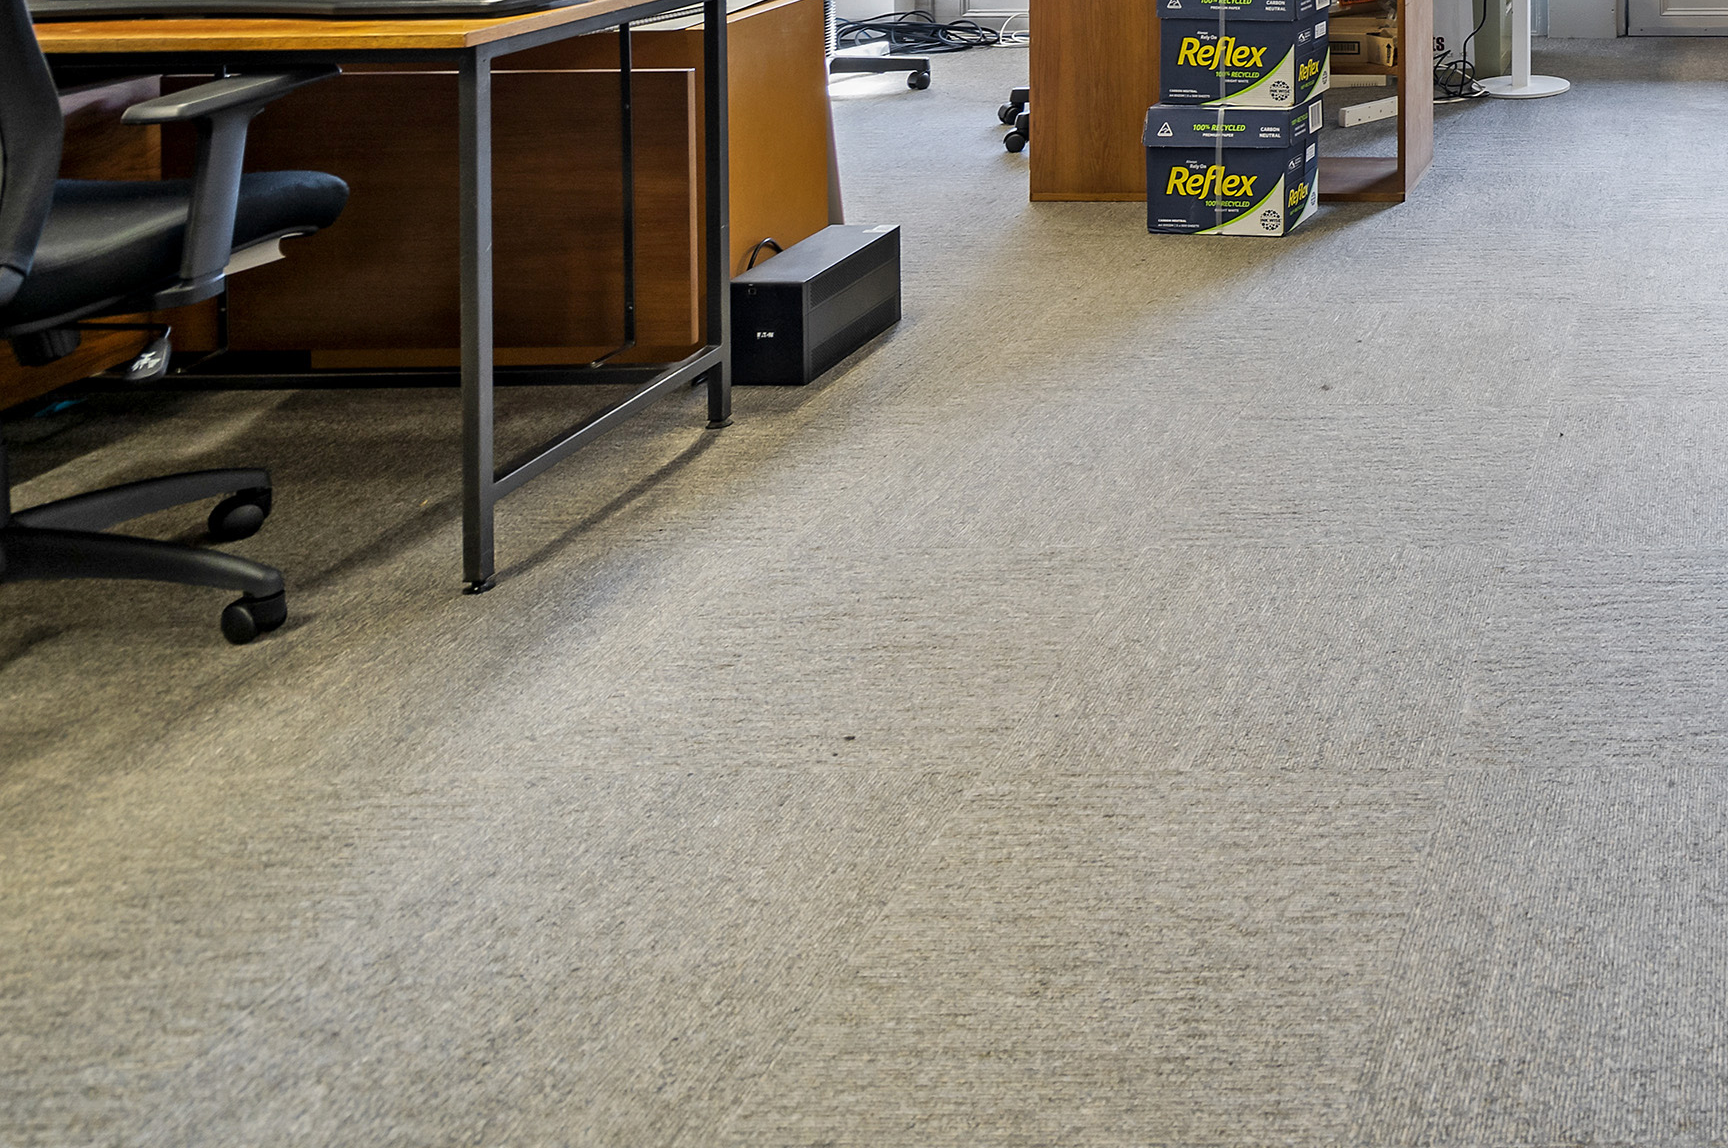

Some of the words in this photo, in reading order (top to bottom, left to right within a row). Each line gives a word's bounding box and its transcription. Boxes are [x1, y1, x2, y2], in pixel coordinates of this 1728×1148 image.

[1177, 36, 1268, 71] Reflex
[1298, 58, 1320, 82] Reflex
[1166, 164, 1258, 200] Reflex
[1288, 182, 1310, 208] Reflex
